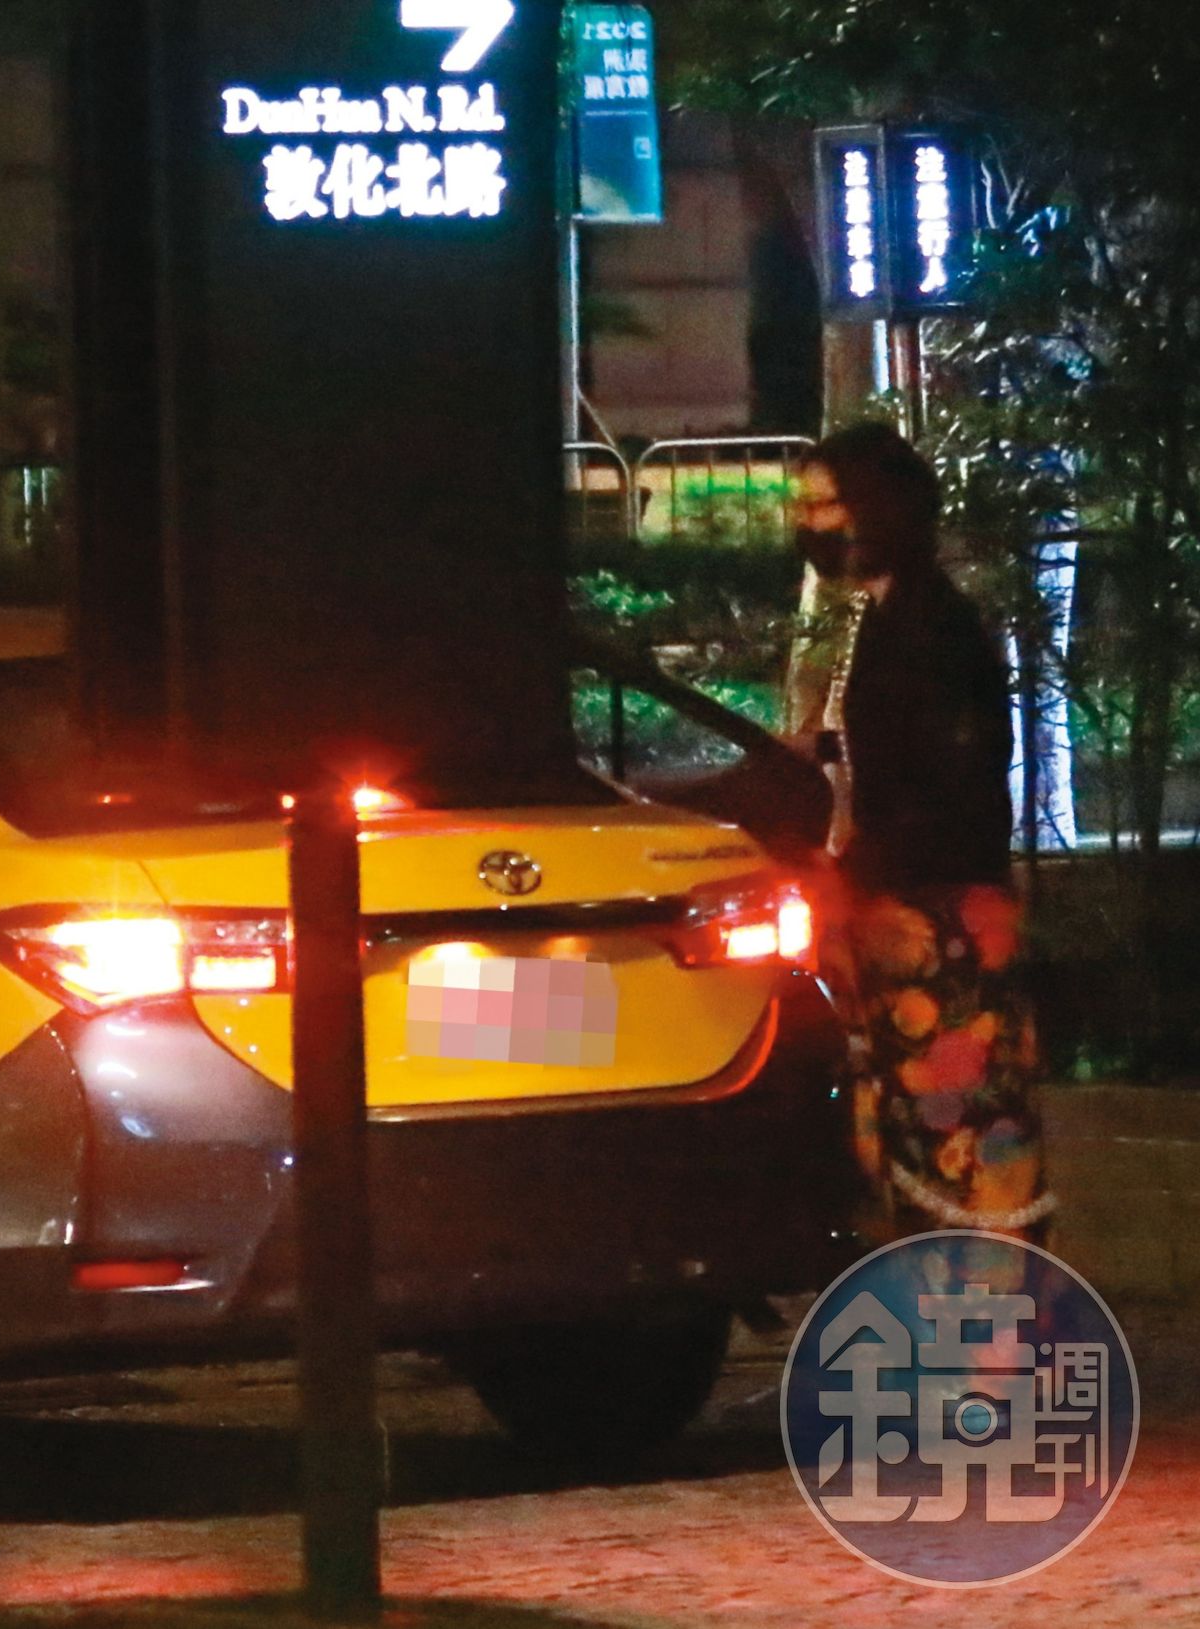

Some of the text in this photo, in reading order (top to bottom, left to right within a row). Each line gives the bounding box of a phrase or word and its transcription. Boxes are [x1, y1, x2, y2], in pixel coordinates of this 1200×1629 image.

[383, 86, 436, 133] N.
[437, 82, 506, 132] Rd.
[262, 143, 507, 221] 敦化北路
